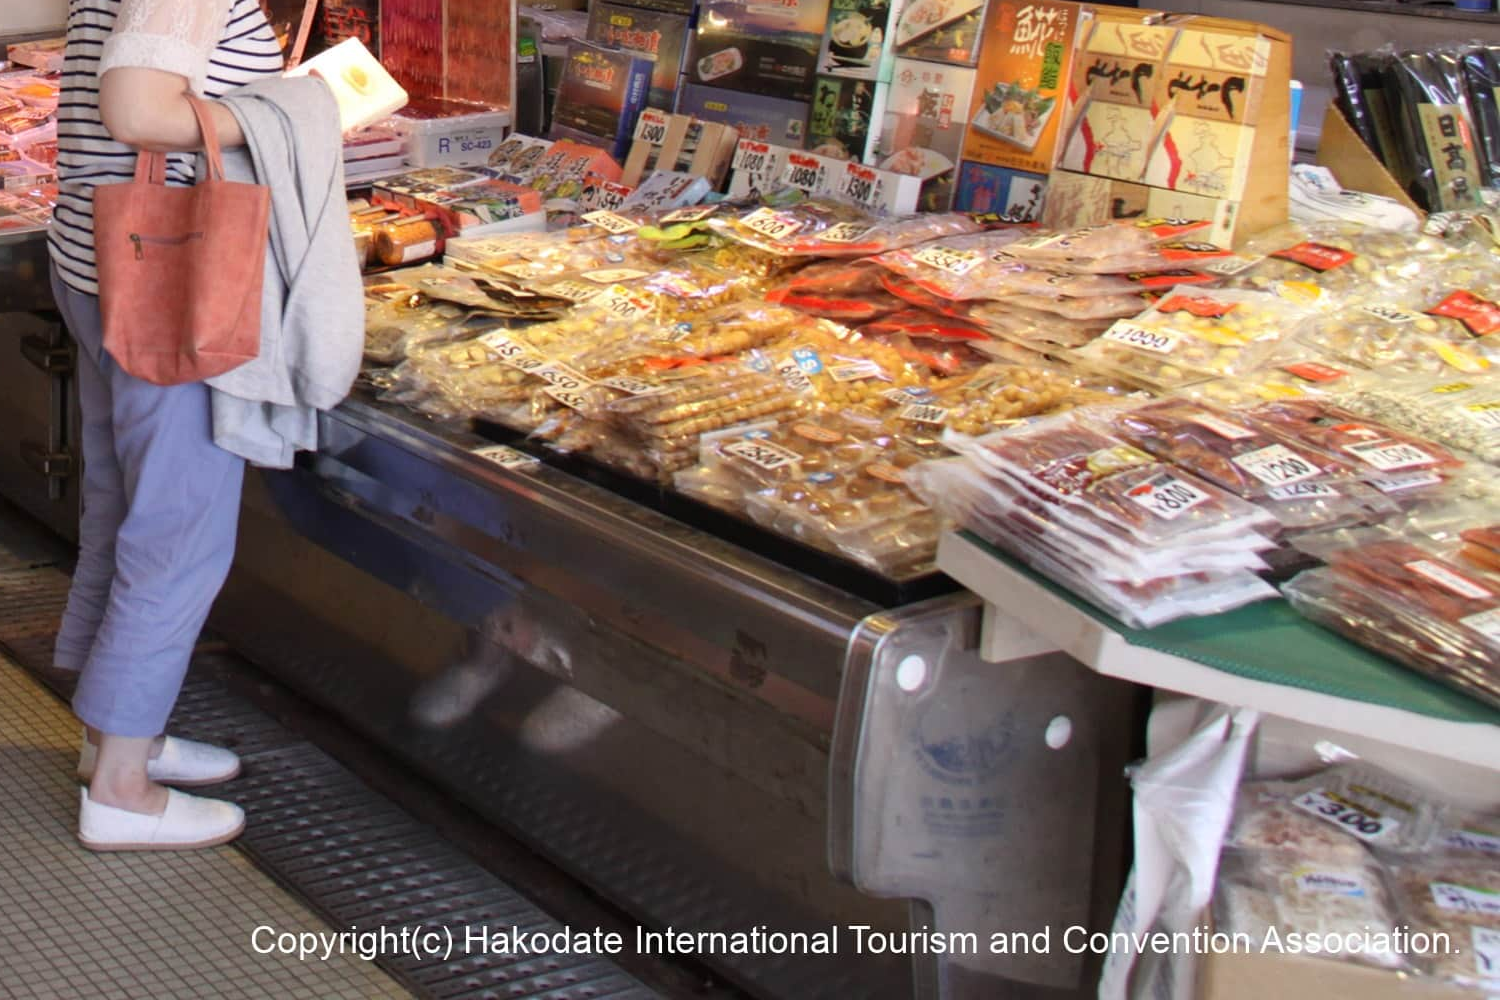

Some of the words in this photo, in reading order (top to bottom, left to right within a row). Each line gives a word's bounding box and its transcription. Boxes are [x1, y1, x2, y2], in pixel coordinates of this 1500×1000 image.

[639, 123, 665, 143] 1300
[438, 137, 450, 154] R
[460, 139, 492, 152] SC-423
[740, 152, 765, 171] 1080
[789, 165, 817, 188] 1080
[846, 180, 871, 201] 1300
